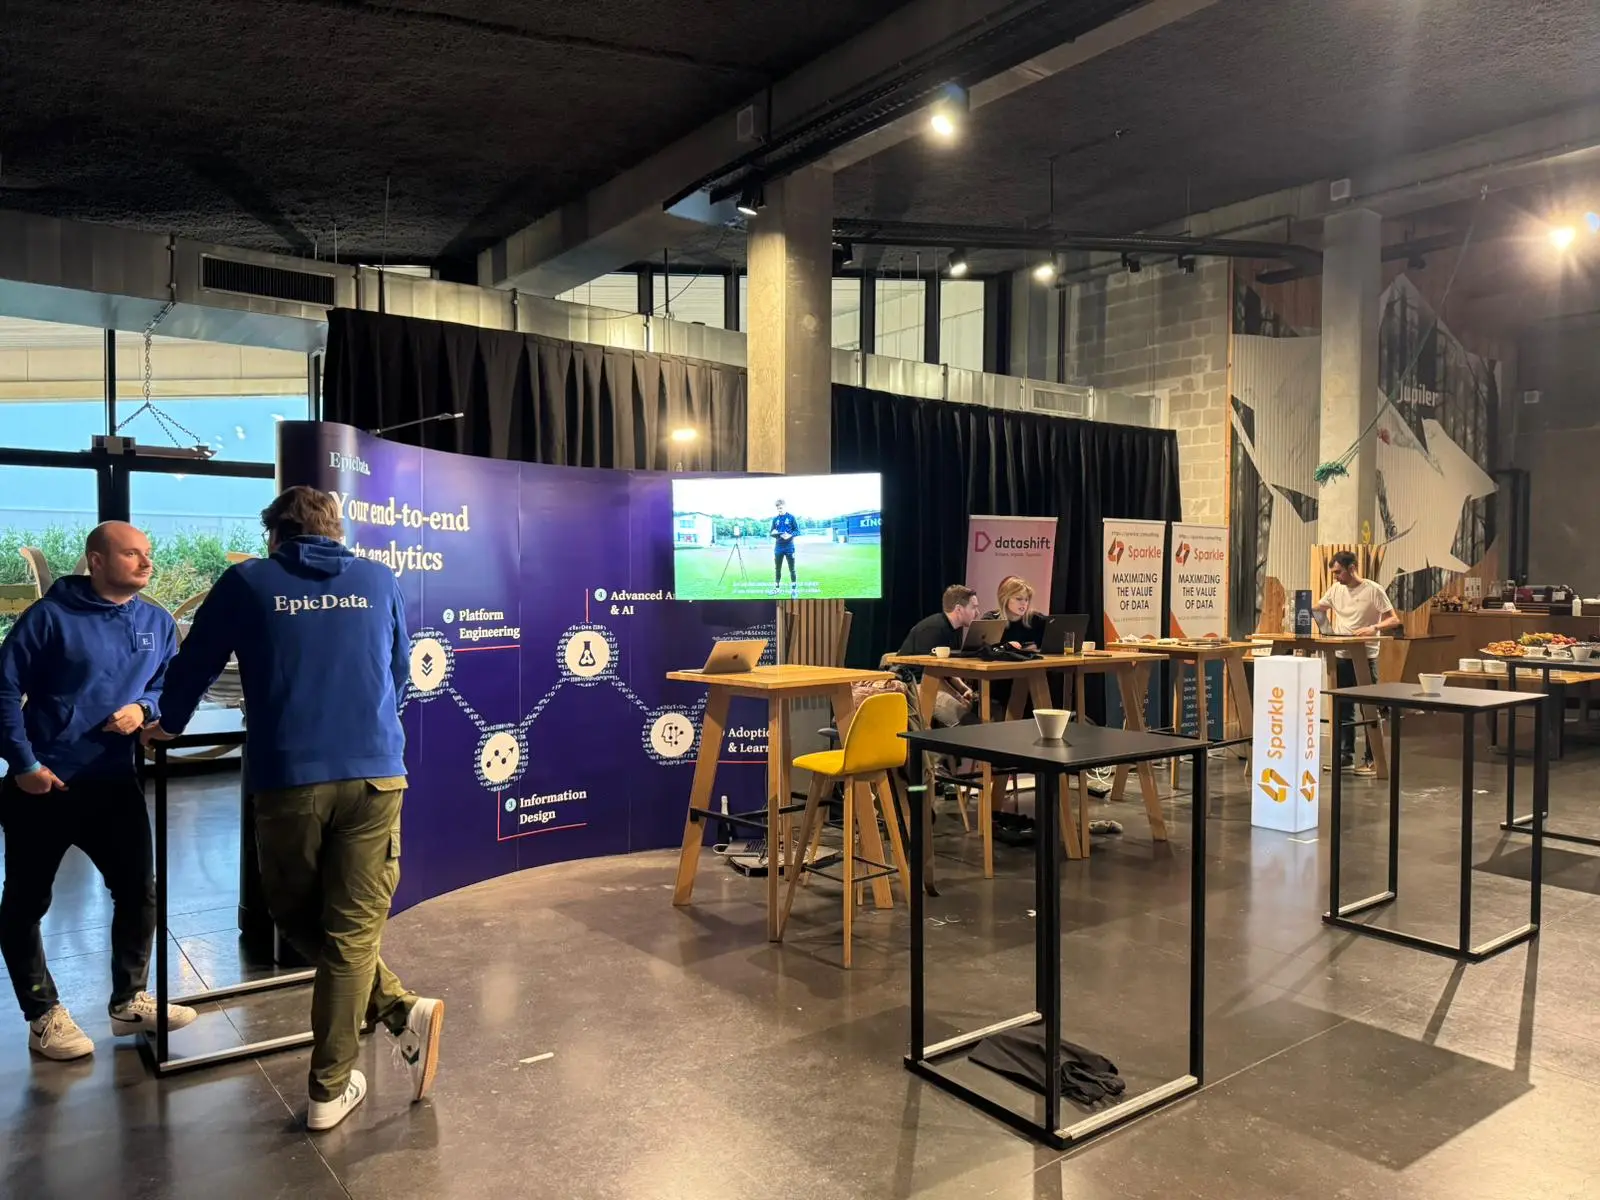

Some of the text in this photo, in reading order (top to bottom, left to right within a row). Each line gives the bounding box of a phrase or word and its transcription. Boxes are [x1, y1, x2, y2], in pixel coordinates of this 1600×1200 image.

[1397, 381, 1440, 409] Jupiler
[328, 491, 470, 532] Your end-to-end
[995, 535, 1051, 550] datashift
[368, 540, 443, 577] analytics
[1128, 545, 1162, 560] Sparkle
[1194, 548, 1225, 562] Sparkle
[1112, 573, 1158, 583] MAXIMIZING
[1178, 574, 1221, 584] MAXIMIZING
[611, 590, 663, 601] Advanced
[1117, 586, 1153, 597] THE VALUE
[1182, 587, 1217, 597] THE VALUE
[273, 593, 374, 616] EpicData.
[610, 604, 635, 615] & AI
[1120, 600, 1149, 610] OF DATA
[1185, 600, 1213, 609] OF DATA
[459, 607, 505, 621] Platform
[459, 625, 521, 641] Engineering
[1267, 686, 1286, 760] Sparkle
[1304, 687, 1315, 760] Sparkle
[728, 742, 737, 753] &
[520, 789, 587, 808] Information
[520, 810, 556, 825] Design
